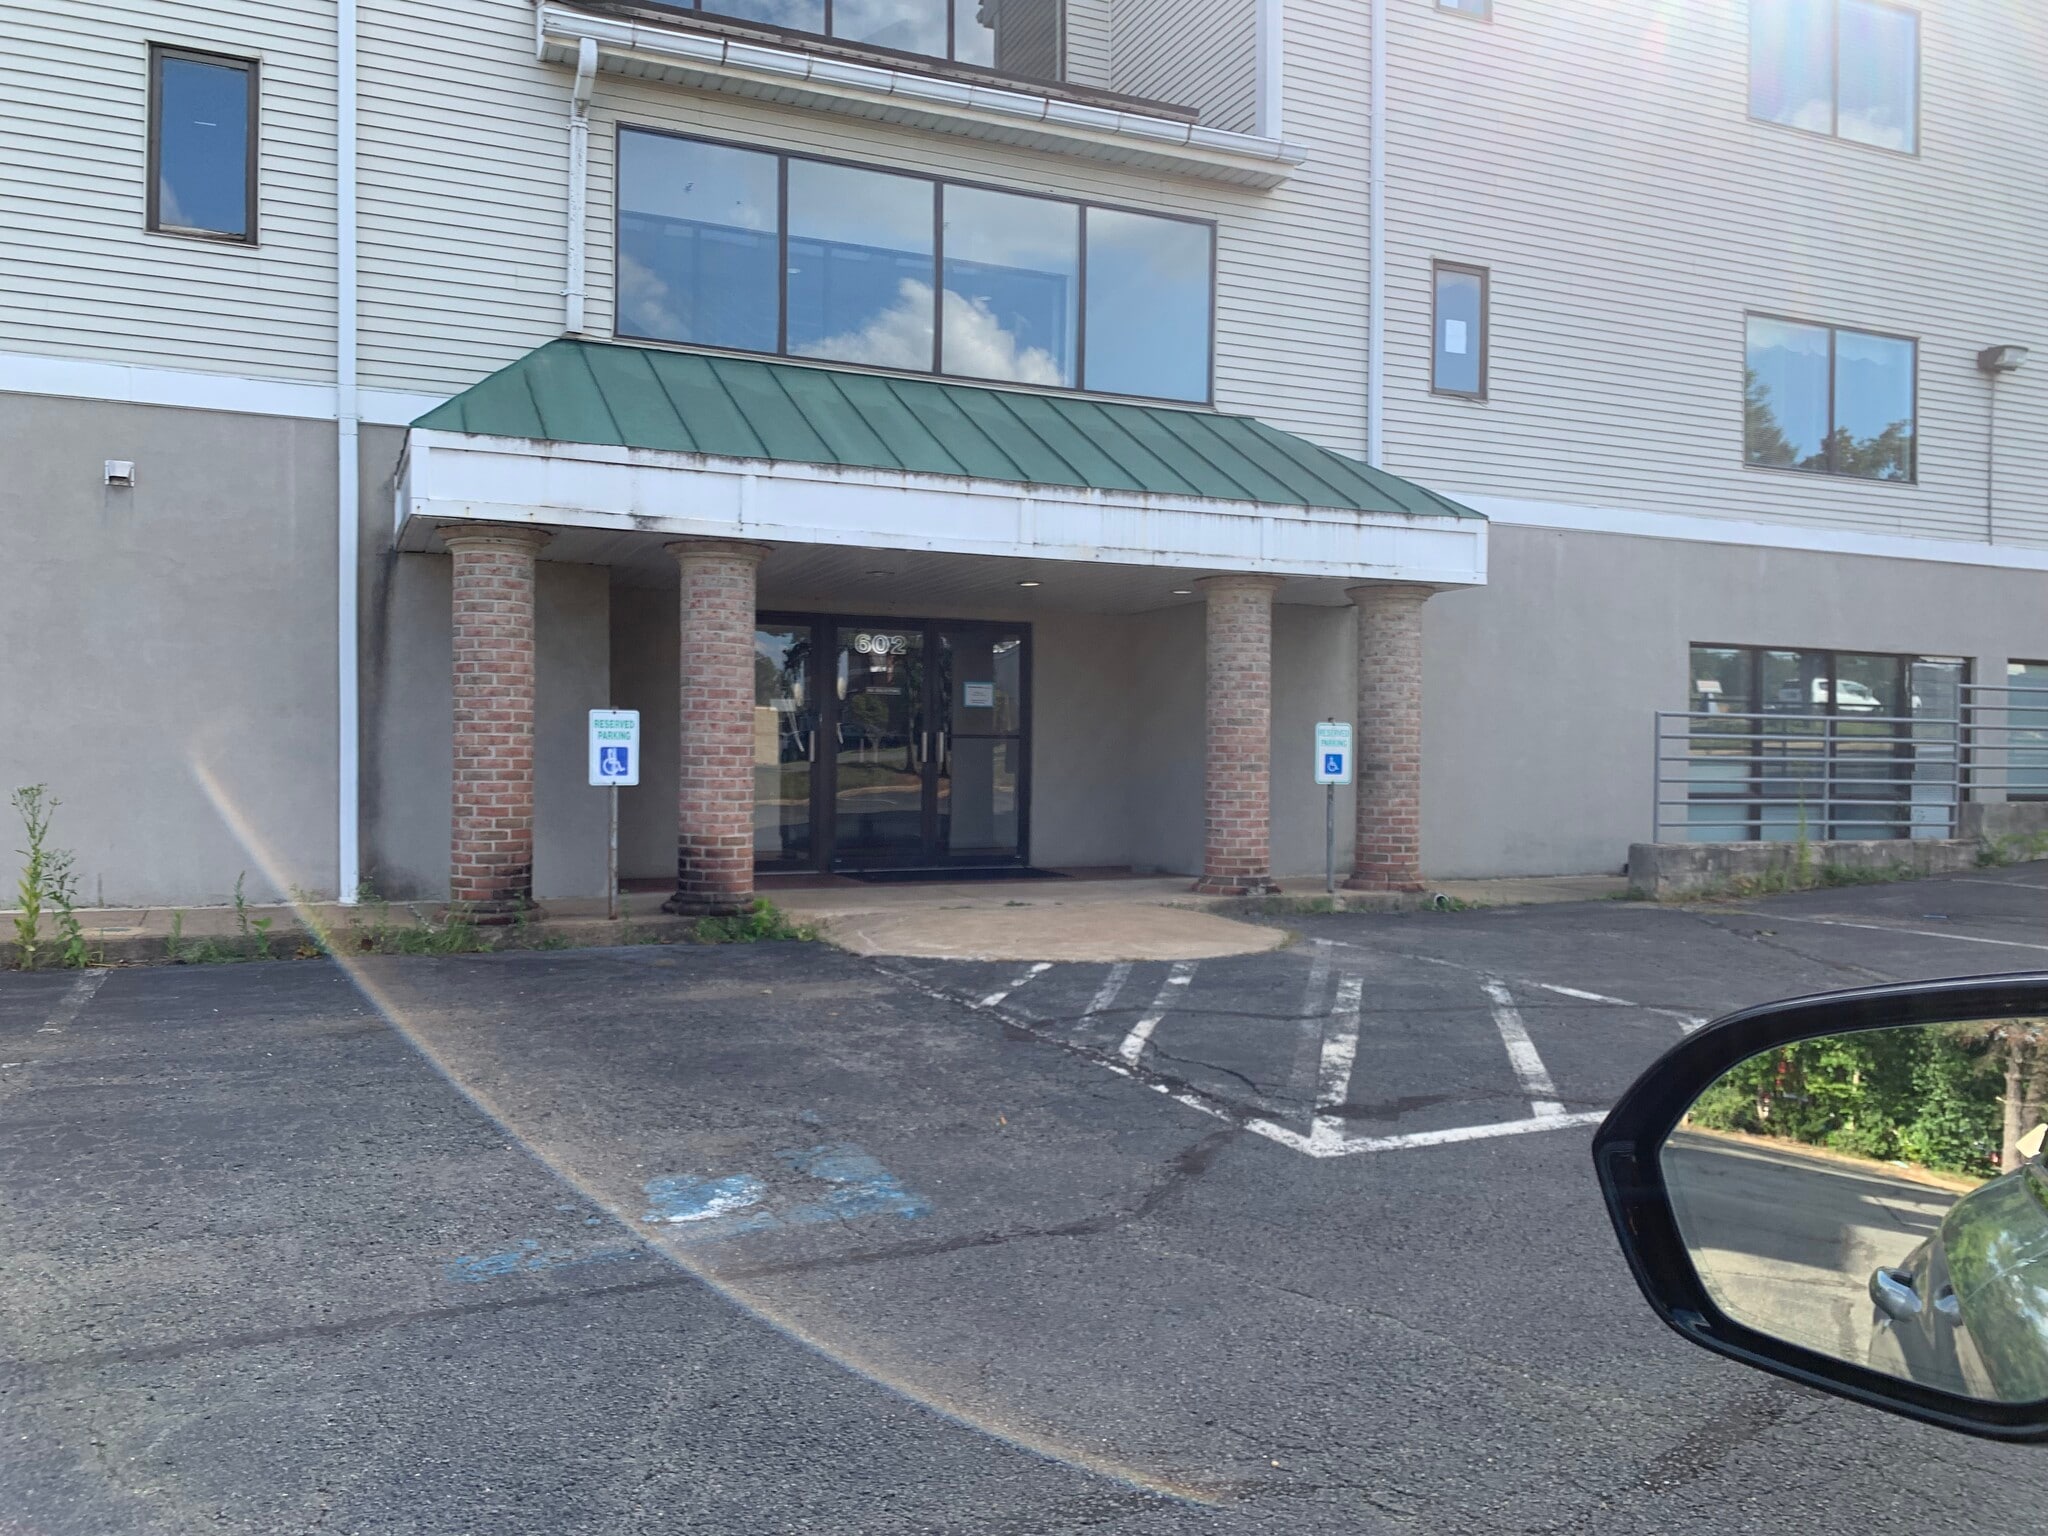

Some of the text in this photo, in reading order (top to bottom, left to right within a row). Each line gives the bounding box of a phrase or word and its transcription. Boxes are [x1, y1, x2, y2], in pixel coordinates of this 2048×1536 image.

[855, 634, 907, 655] 602
[594, 719, 635, 729] RESERVED
[598, 731, 631, 740] PARKING
